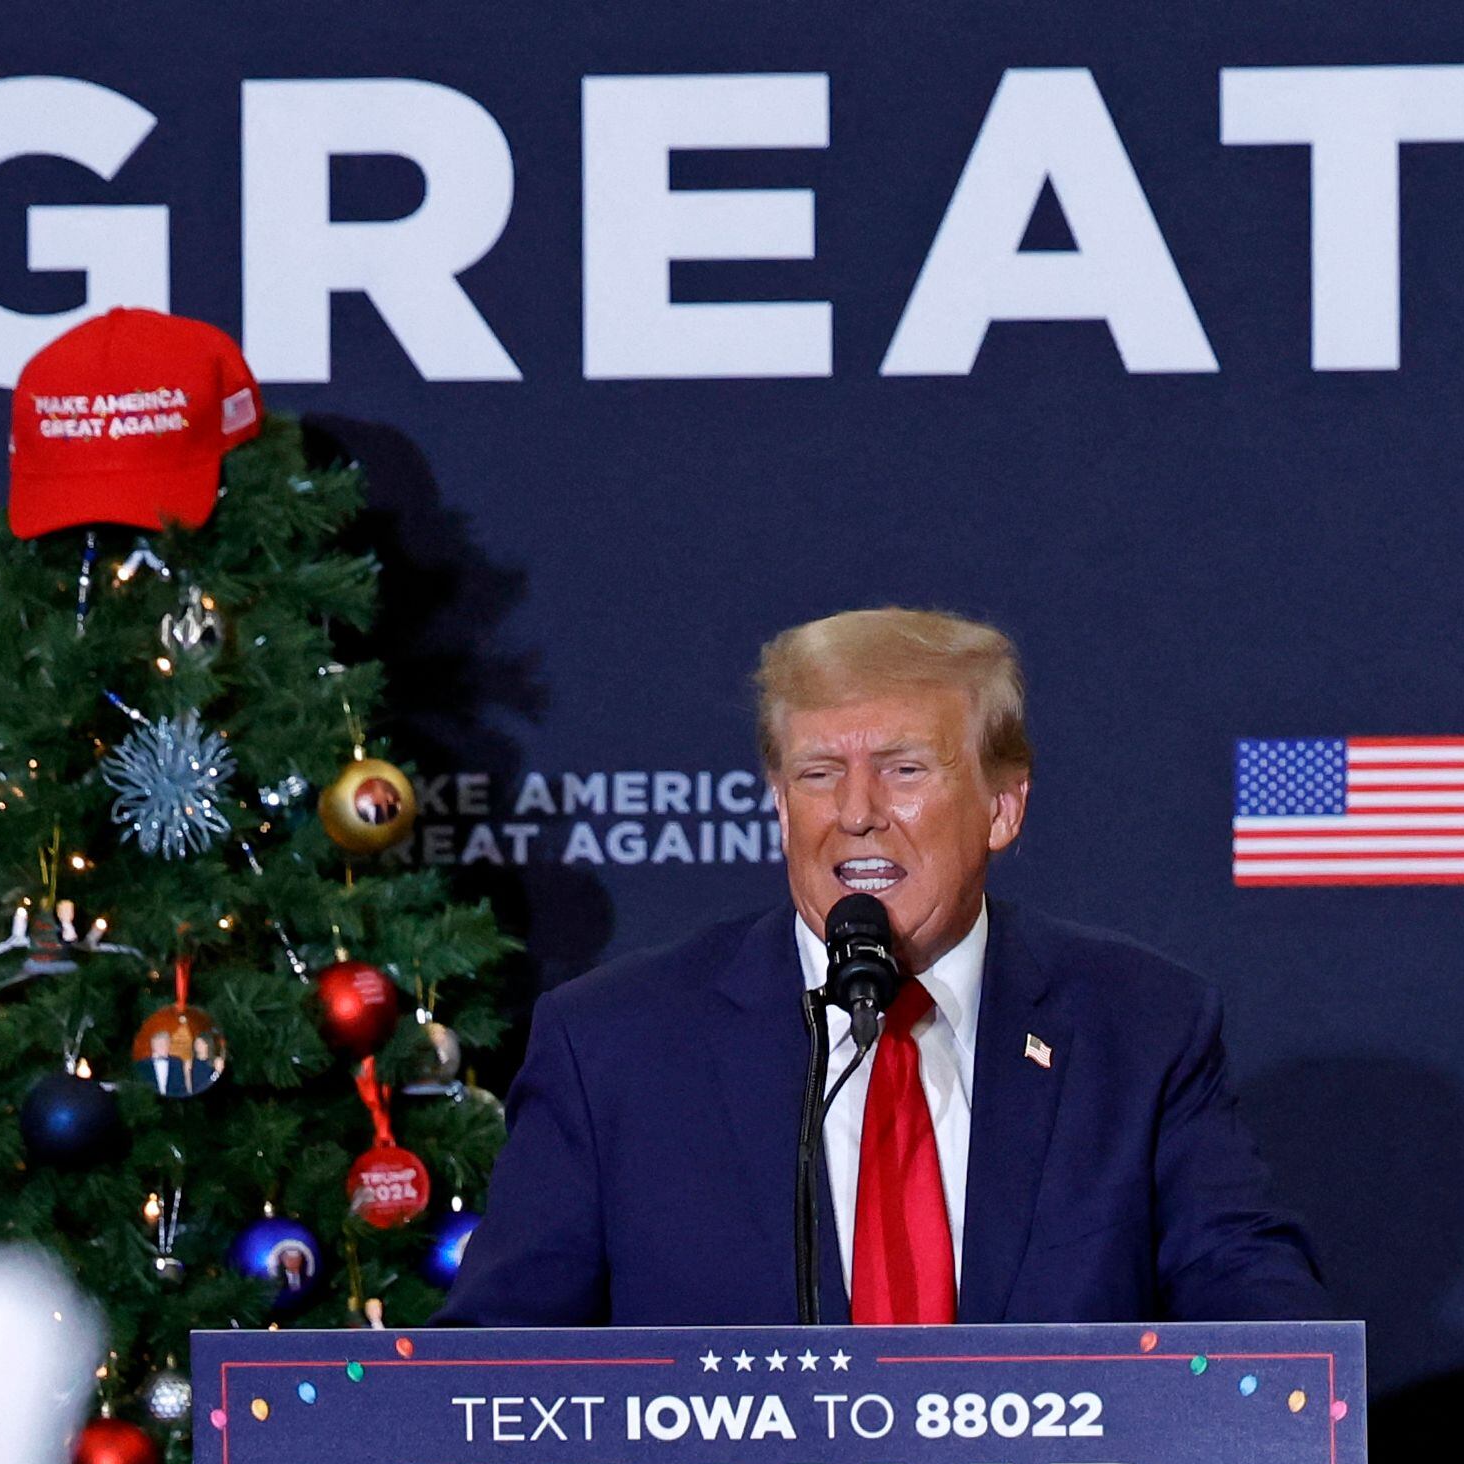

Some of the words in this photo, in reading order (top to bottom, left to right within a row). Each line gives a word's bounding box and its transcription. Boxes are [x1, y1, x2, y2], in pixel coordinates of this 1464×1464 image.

[34, 395, 89, 415] MAKE
[91, 387, 188, 414] AMERICA
[40, 418, 105, 438] GREAT
[417, 773, 492, 816] KE
[562, 818, 785, 865] AGAIN!
[451, 1396, 605, 1442] TEXT
[626, 1395, 797, 1441] IOWA
[813, 1393, 895, 1440] TO
[915, 1392, 1104, 1440] 88022
